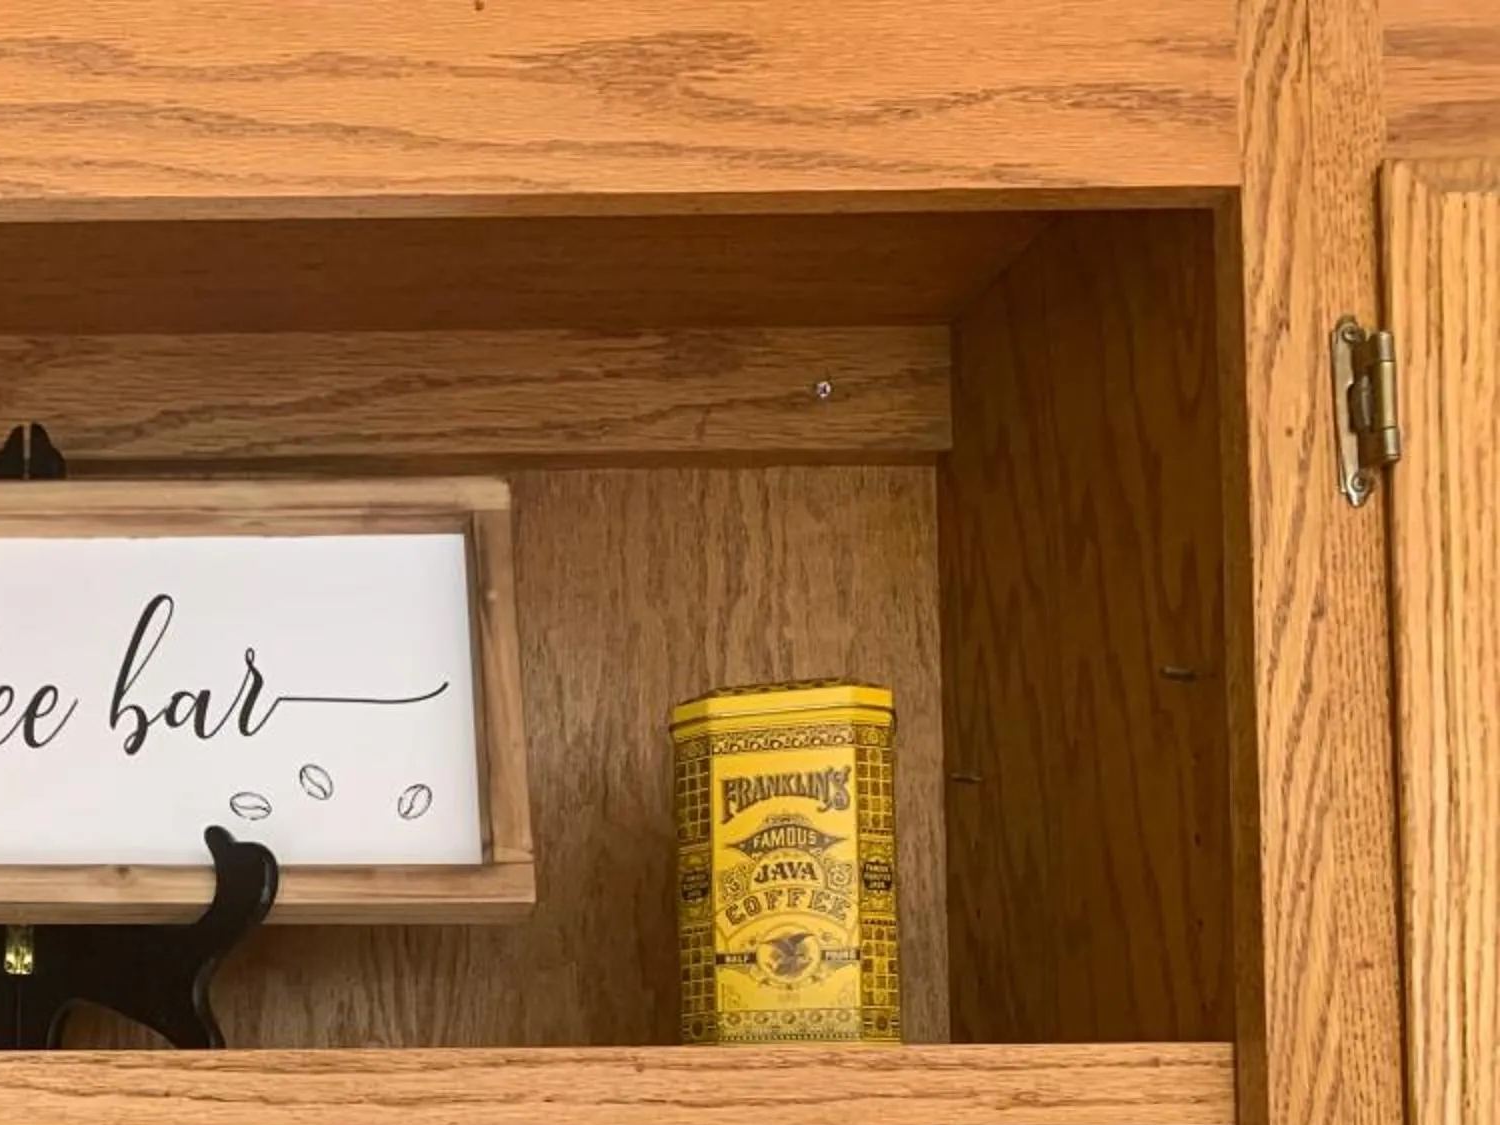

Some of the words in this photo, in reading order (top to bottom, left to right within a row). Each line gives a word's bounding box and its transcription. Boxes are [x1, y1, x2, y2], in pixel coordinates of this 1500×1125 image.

[106, 593, 282, 756] bar
[721, 765, 851, 825] FRANKLIN'S
[753, 826, 817, 849] FAMOUS
[754, 861, 818, 883] JAVA
[725, 889, 850, 926] COFFEE
